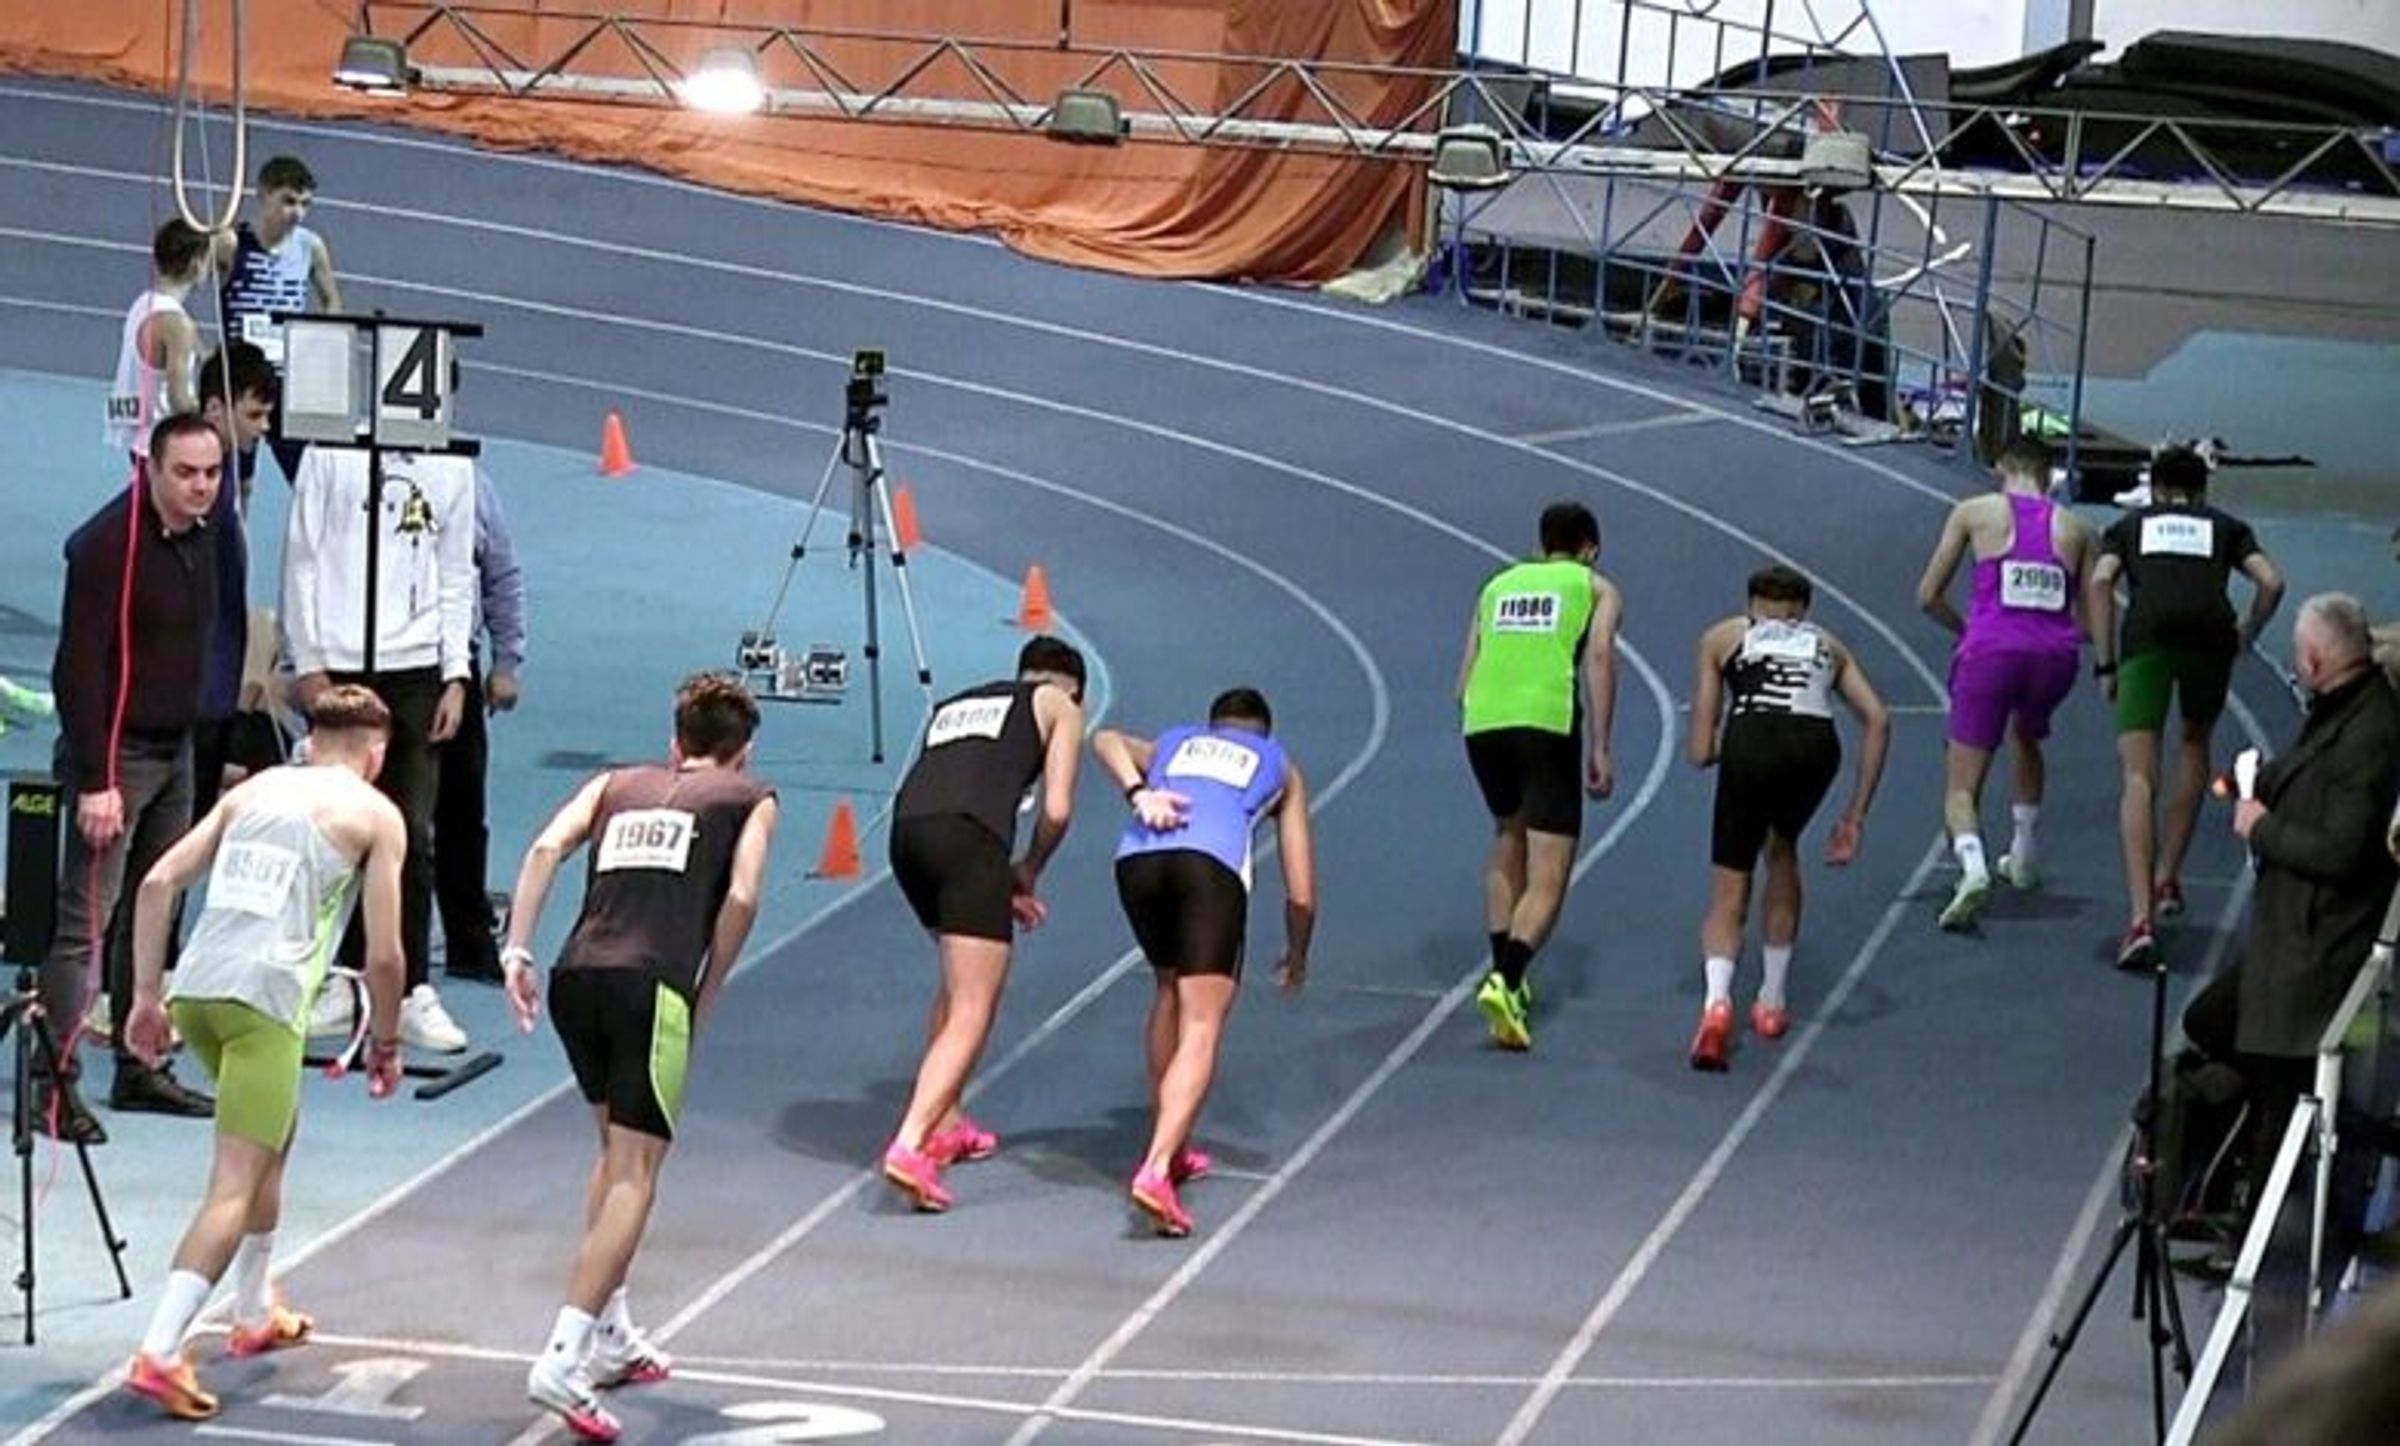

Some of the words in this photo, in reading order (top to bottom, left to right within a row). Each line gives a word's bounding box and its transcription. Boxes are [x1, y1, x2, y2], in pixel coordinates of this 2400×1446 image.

[382, 325, 441, 420] 4
[614, 819, 684, 850] 1967
[258, 1357, 430, 1420] 1
